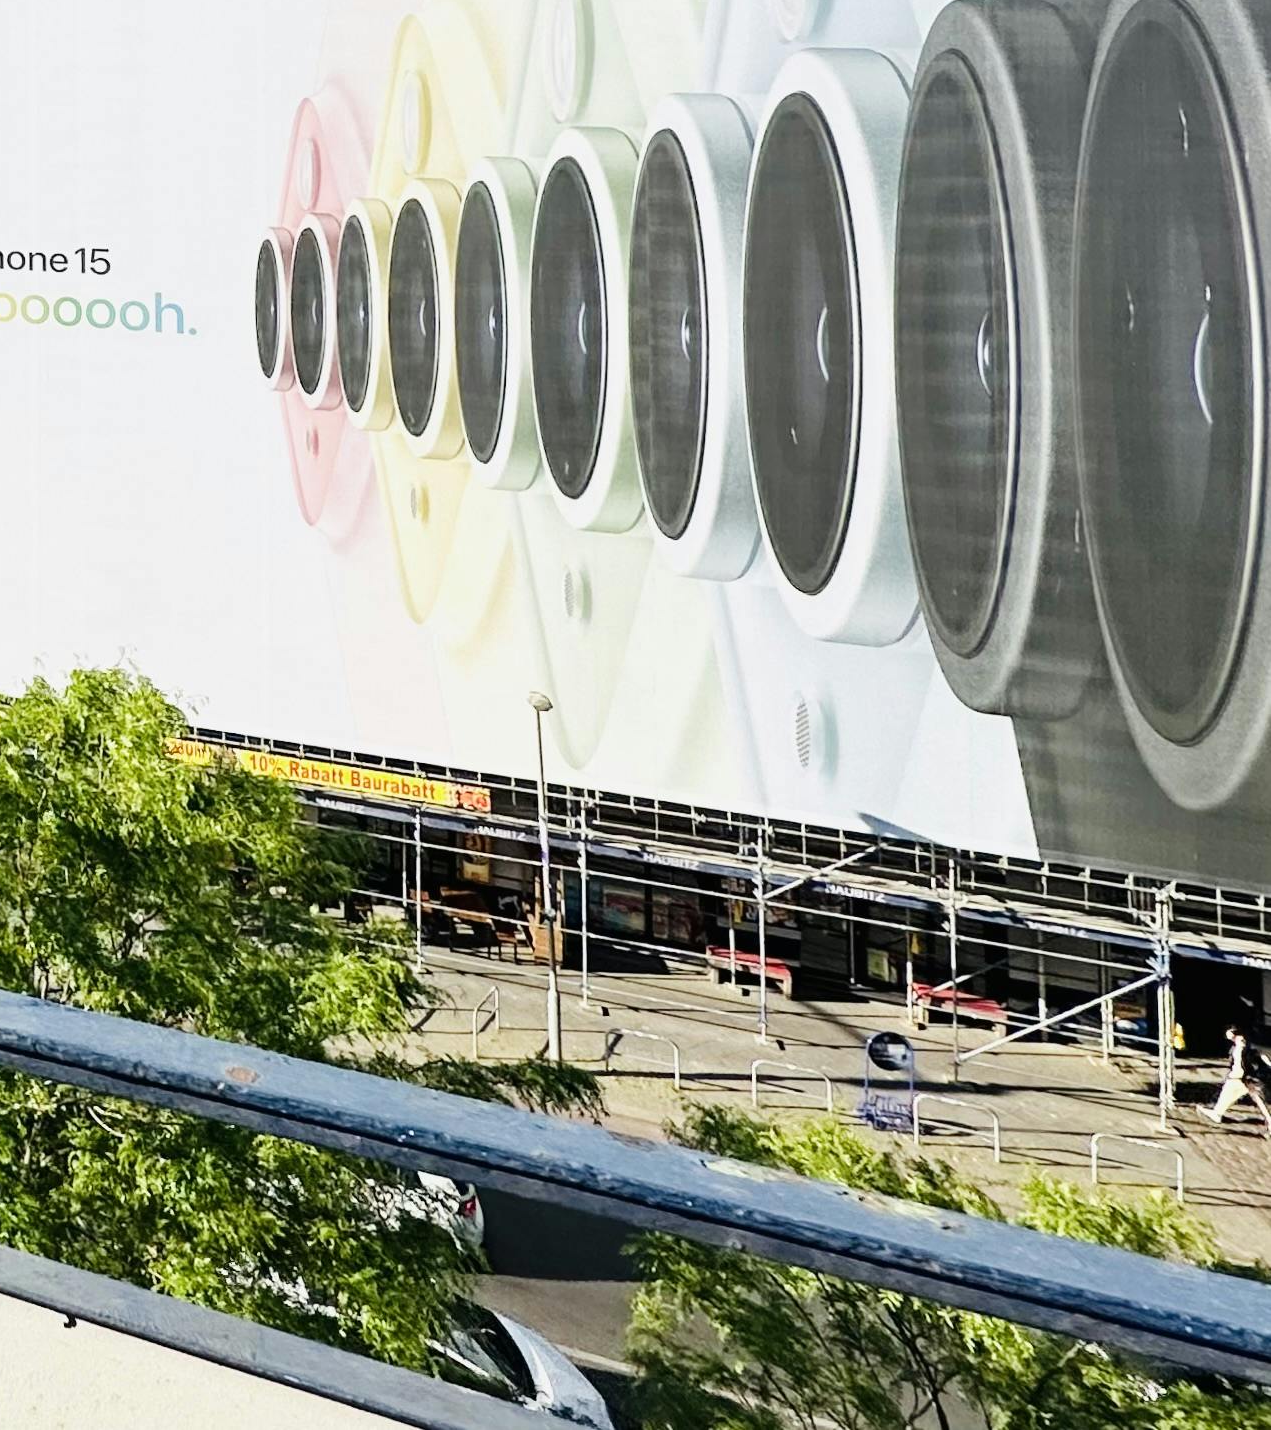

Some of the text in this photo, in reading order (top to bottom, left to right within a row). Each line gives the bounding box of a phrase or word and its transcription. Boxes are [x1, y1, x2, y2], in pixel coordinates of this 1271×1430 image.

[74, 247, 112, 276] 15
[289, 760, 344, 786] Rabatt
[350, 770, 437, 801] Baurabatt
